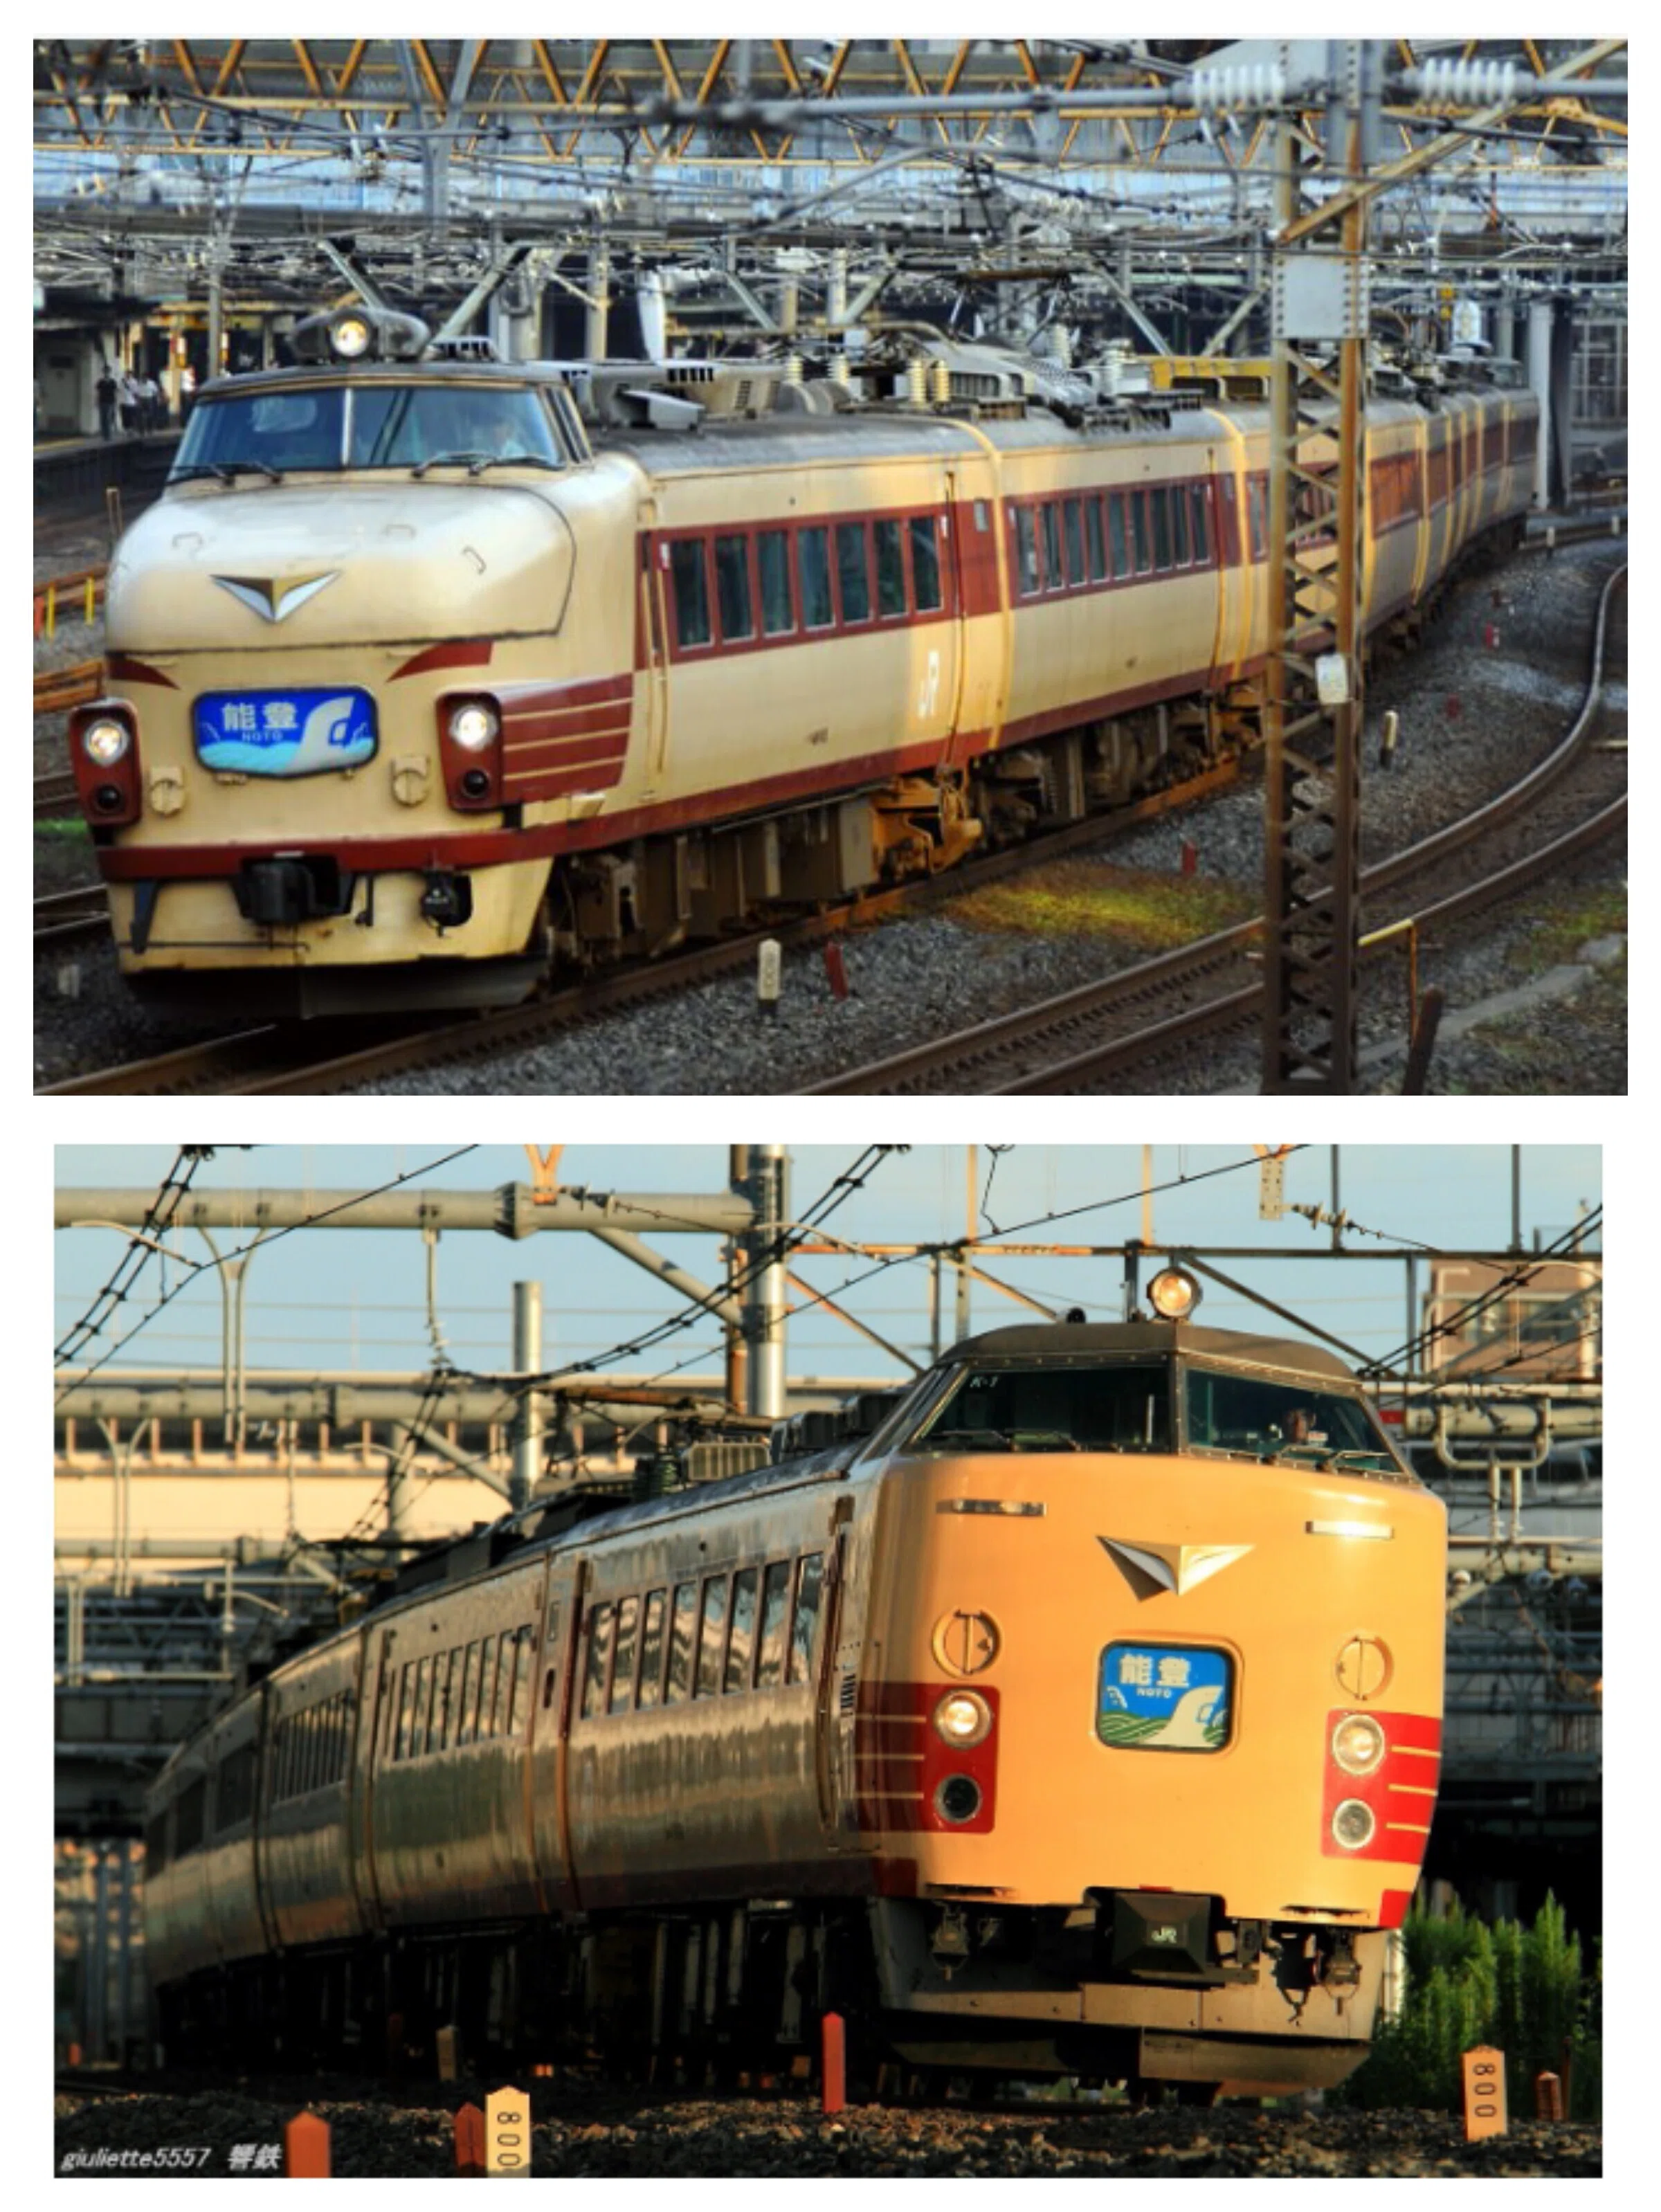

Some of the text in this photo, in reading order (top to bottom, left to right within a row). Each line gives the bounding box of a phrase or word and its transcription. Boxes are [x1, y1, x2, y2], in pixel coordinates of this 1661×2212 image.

[221, 701, 299, 731] 能登
[242, 732, 283, 741] NOTO
[1119, 1653, 1190, 1687] 能登
[1136, 1687, 1172, 1698] NOTO
[1151, 1926, 1177, 1943] JR
[1473, 2063, 1496, 2117] 800
[497, 2112, 521, 2166] 800
